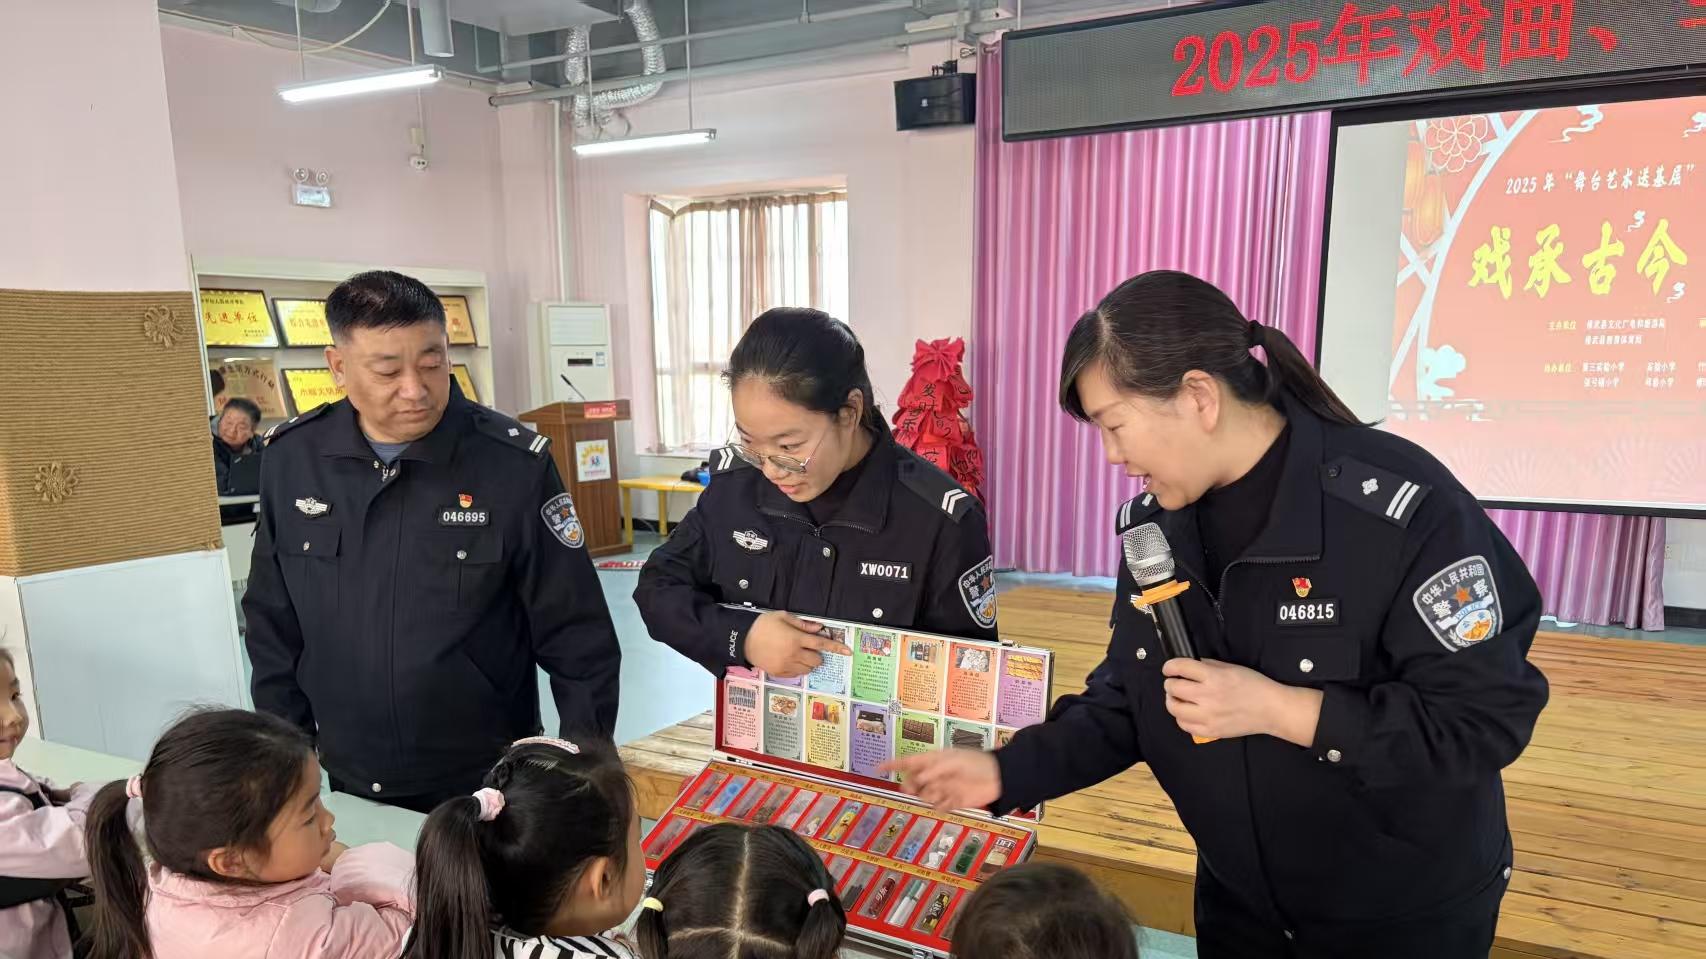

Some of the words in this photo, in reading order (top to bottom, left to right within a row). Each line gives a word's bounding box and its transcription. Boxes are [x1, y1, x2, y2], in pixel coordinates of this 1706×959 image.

[1171, 0, 1706, 97] 2025年戏曲、
[1506, 175, 1538, 194] 2025
[1543, 172, 1556, 192] 年
[1467, 218, 1688, 300] 戏承古今
[443, 511, 486, 523] 046695
[860, 562, 908, 579] XW0071
[1421, 563, 1486, 605] 中华人民共和国
[1279, 603, 1335, 621] 046815
[1432, 600, 1452, 618] 警
[1472, 578, 1490, 598] 察
[729, 629, 739, 658] POLICE
